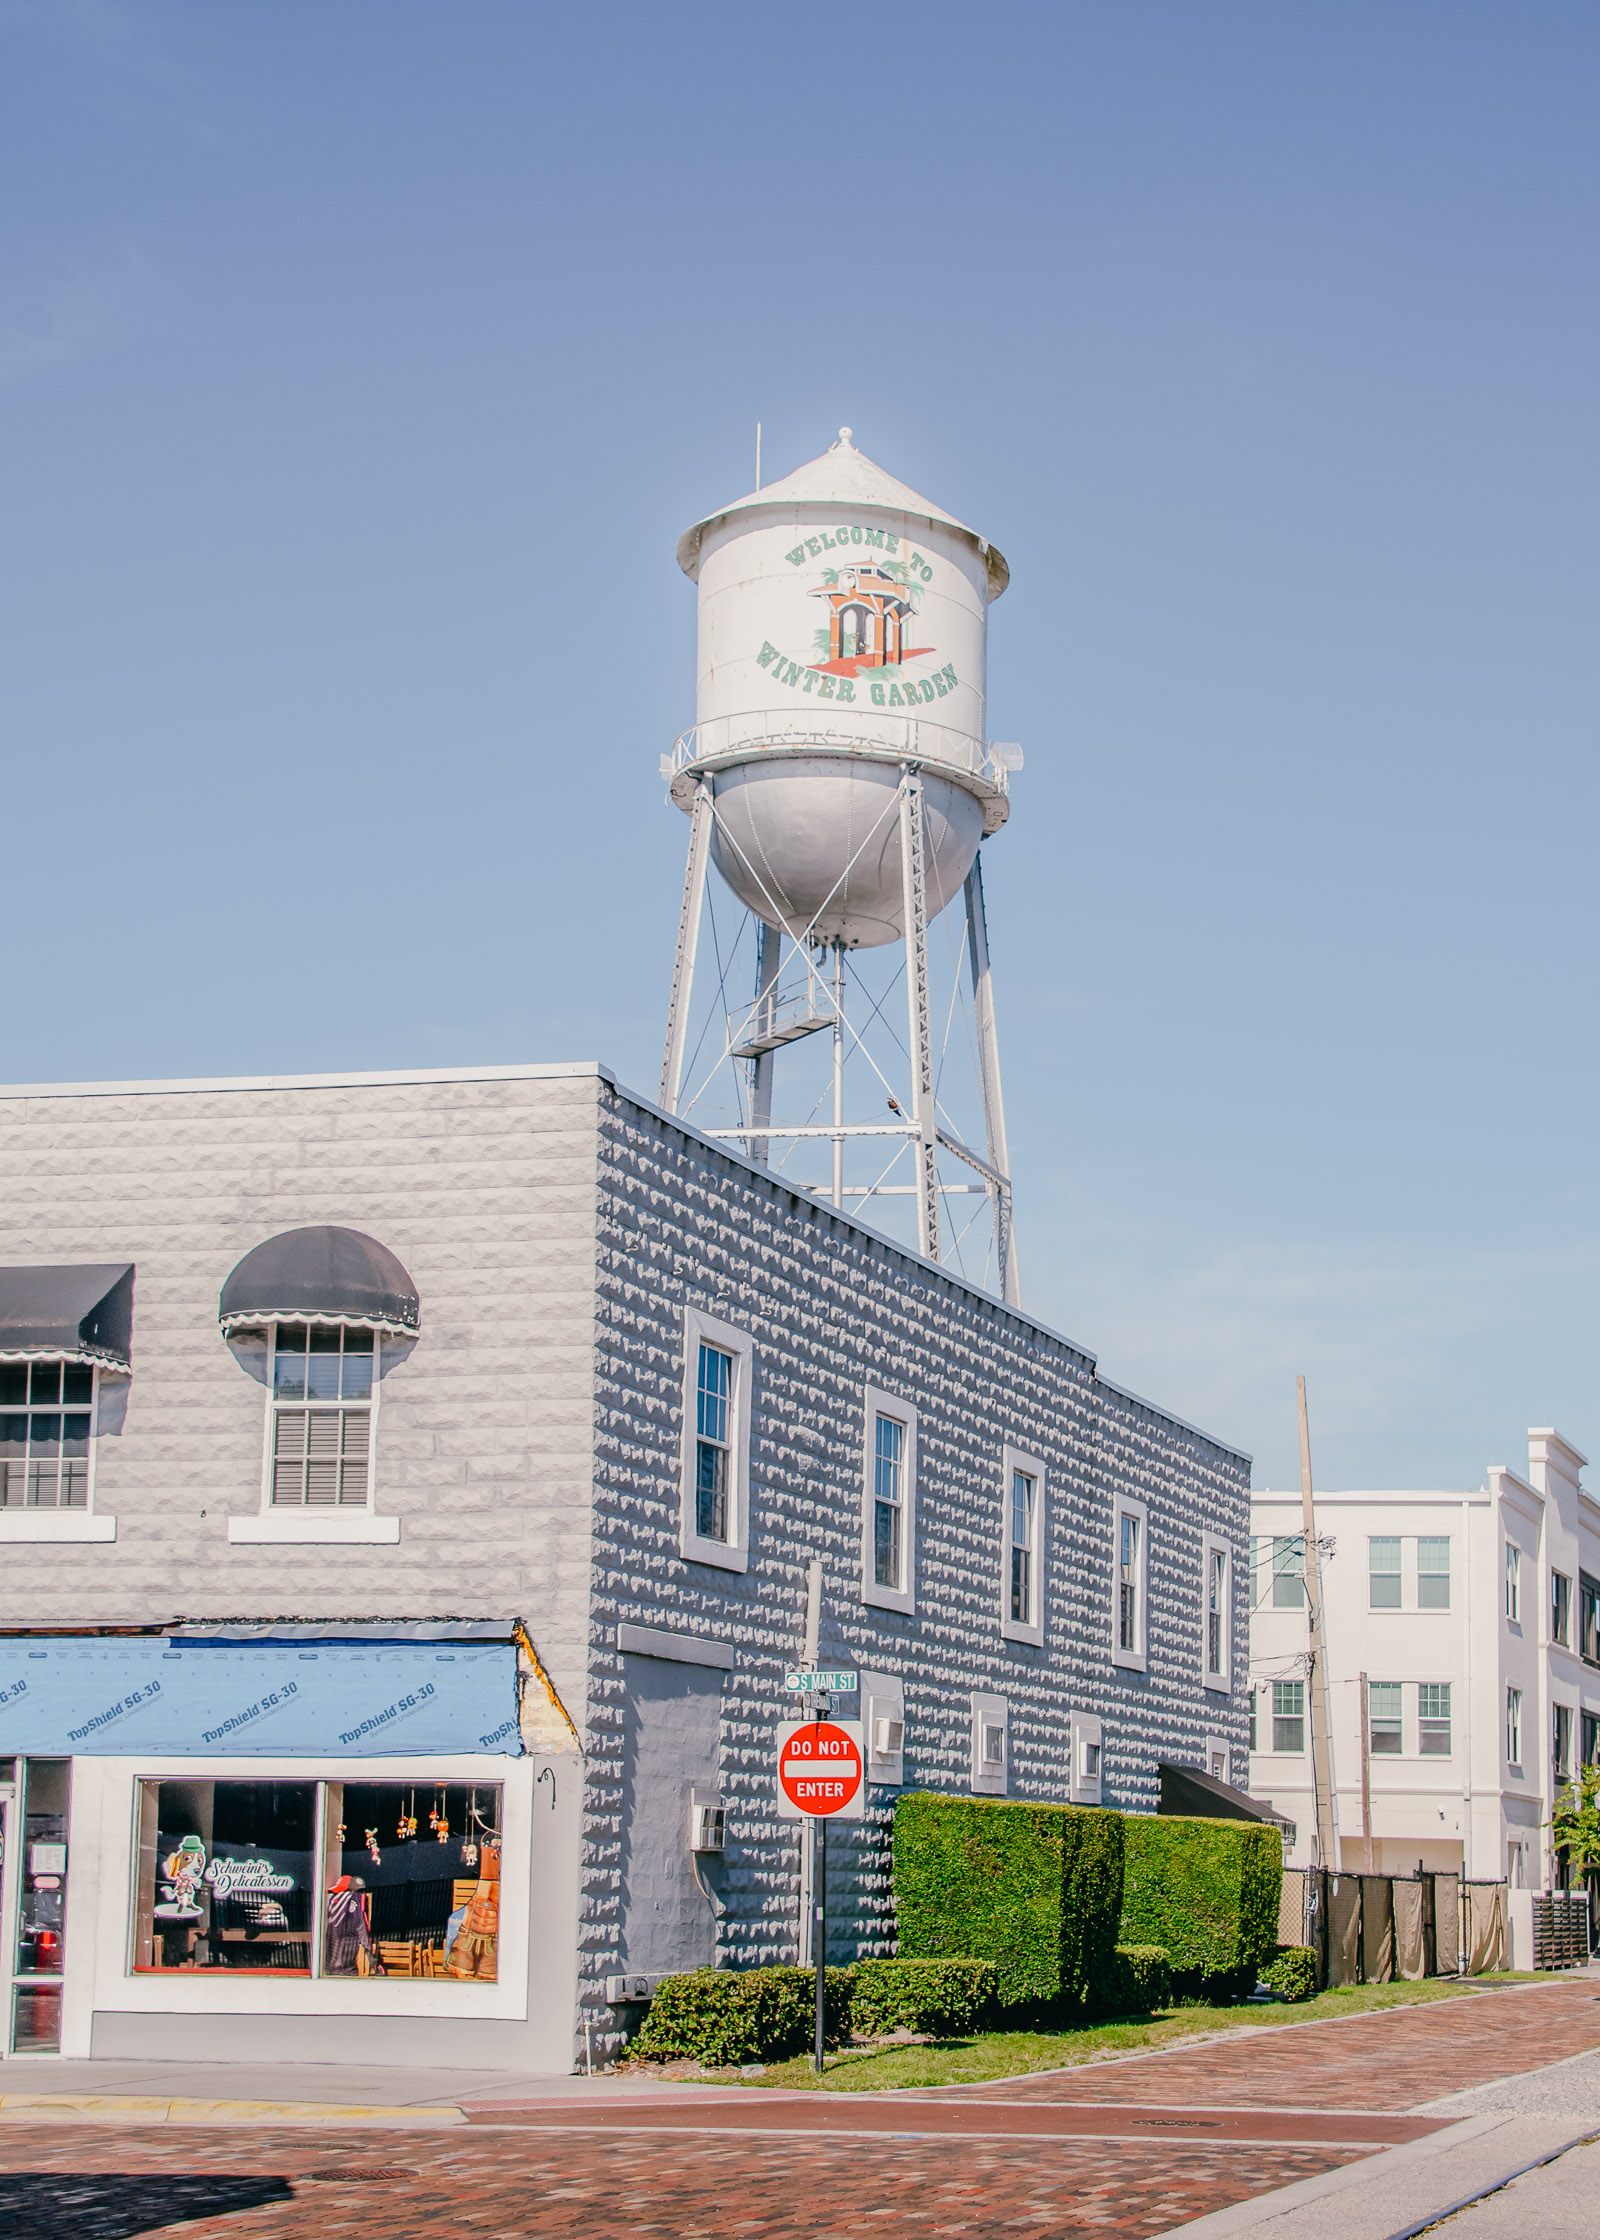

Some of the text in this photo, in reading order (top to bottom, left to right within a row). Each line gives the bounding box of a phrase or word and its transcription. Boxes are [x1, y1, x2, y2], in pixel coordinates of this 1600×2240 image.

[785, 526, 933, 582] WELCOME TO
[756, 641, 959, 706] WINTER GARDEN
[0, 1679, 27, 1704] G-30
[800, 1673, 853, 1690] S MAIN ST
[67, 1702, 123, 1741] TopShield
[124, 1680, 161, 1709] SG-30
[201, 1681, 298, 1743] TopShield SG-30
[339, 1683, 435, 1744] TopShield SG-30
[791, 1741, 850, 1755] DO NOT
[796, 1782, 844, 1797] ENTER
[209, 1860, 270, 1877] Schweini's
[217, 1874, 289, 1894] Delicatessen
